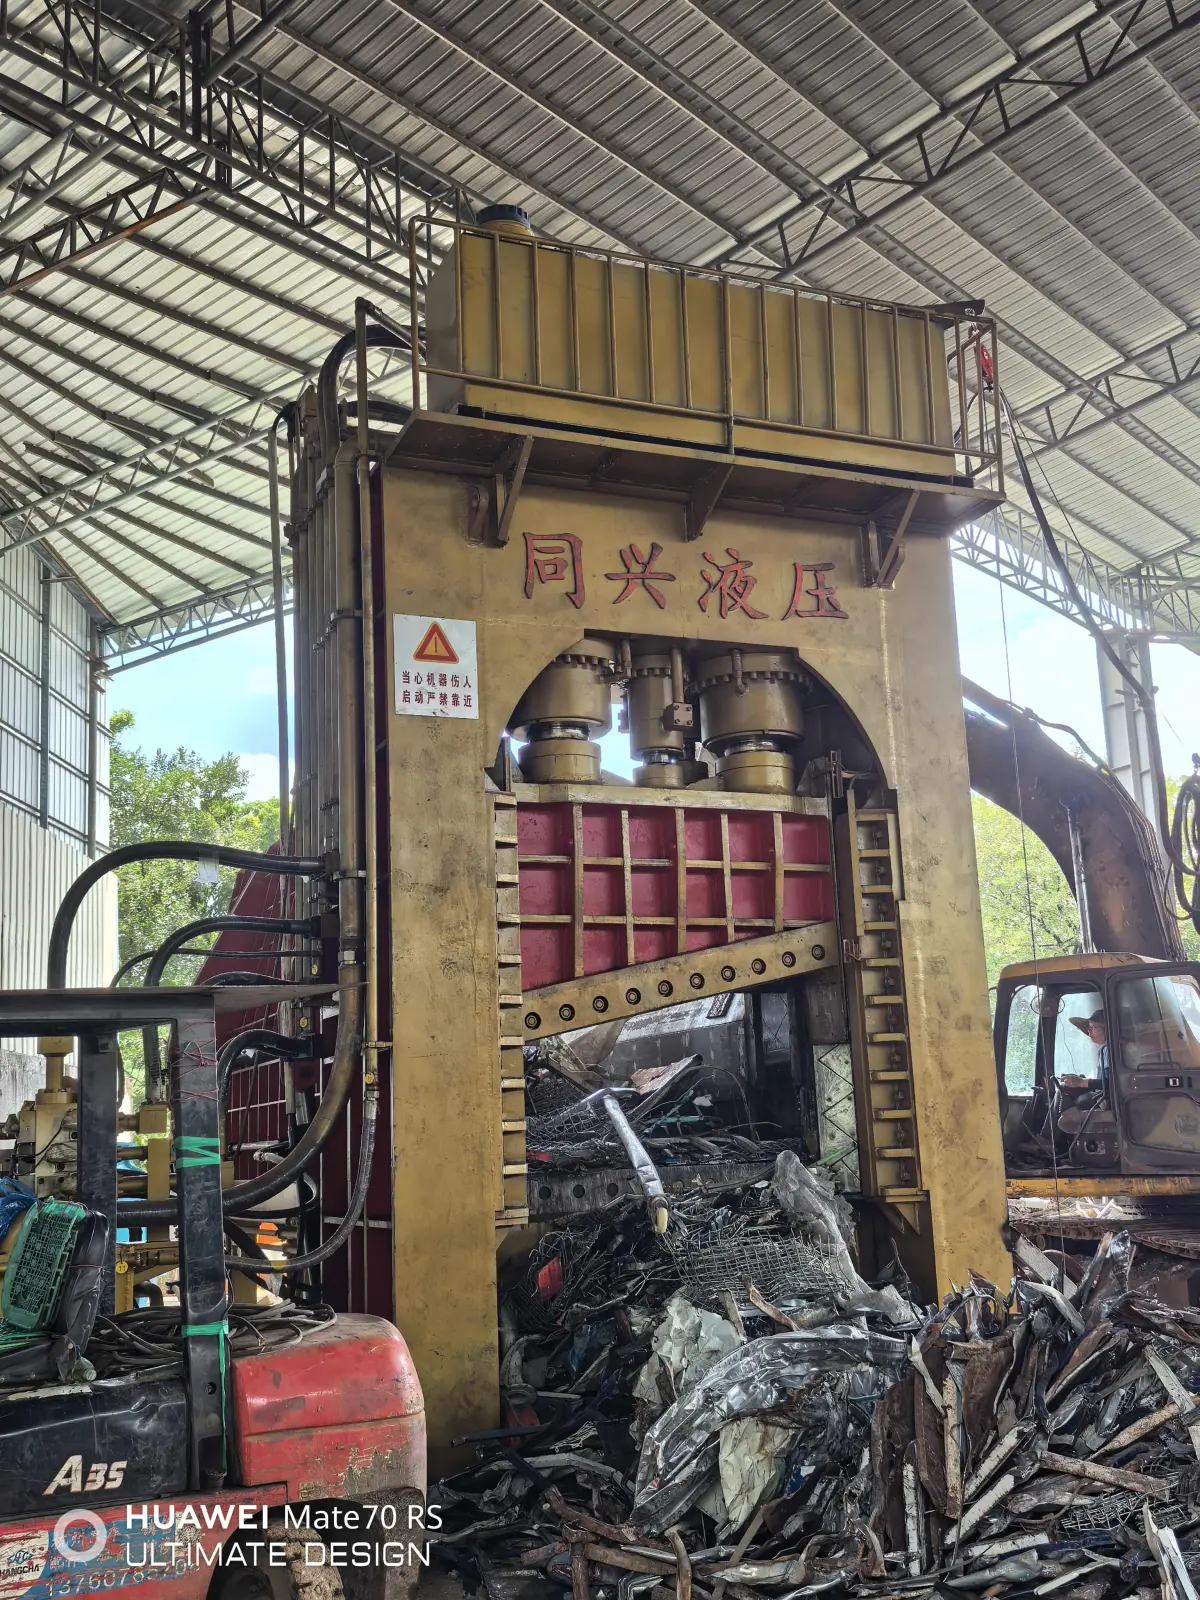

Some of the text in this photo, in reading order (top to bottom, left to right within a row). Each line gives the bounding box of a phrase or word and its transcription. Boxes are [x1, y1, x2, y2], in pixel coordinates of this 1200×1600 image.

[522, 531, 850, 622] 同兴液压
[402, 670, 472, 689] 当心机器伤人
[402, 689, 473, 708] 启动严禁靠近
